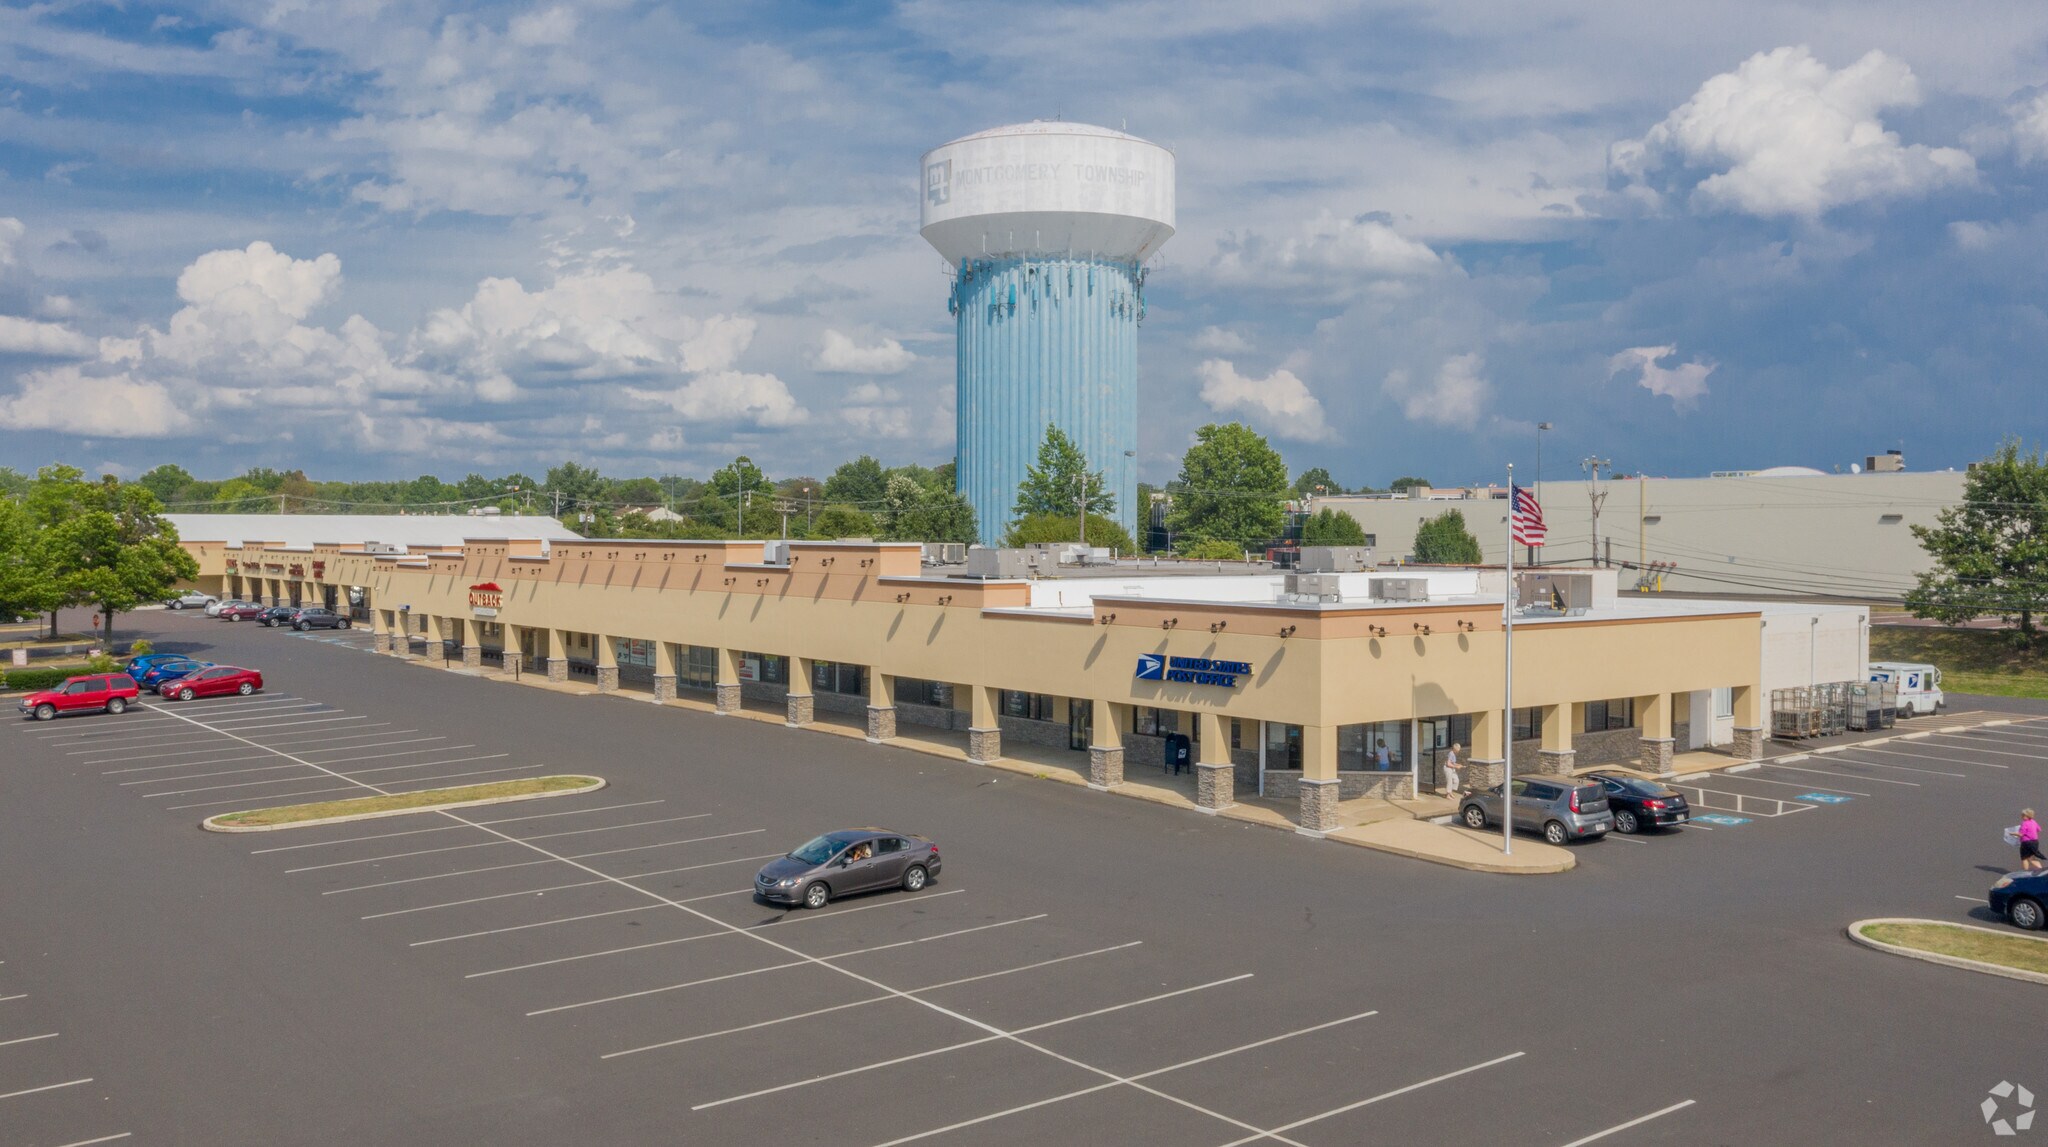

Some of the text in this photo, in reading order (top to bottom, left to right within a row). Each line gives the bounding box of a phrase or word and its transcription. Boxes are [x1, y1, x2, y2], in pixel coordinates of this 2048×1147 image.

[955, 163, 1145, 188] MONTGOMERY TOWNSHIP
[469, 591, 503, 607] OUTBACK
[1169, 655, 1254, 675] UNITED STATES
[1167, 669, 1239, 688] POST OFFICE
